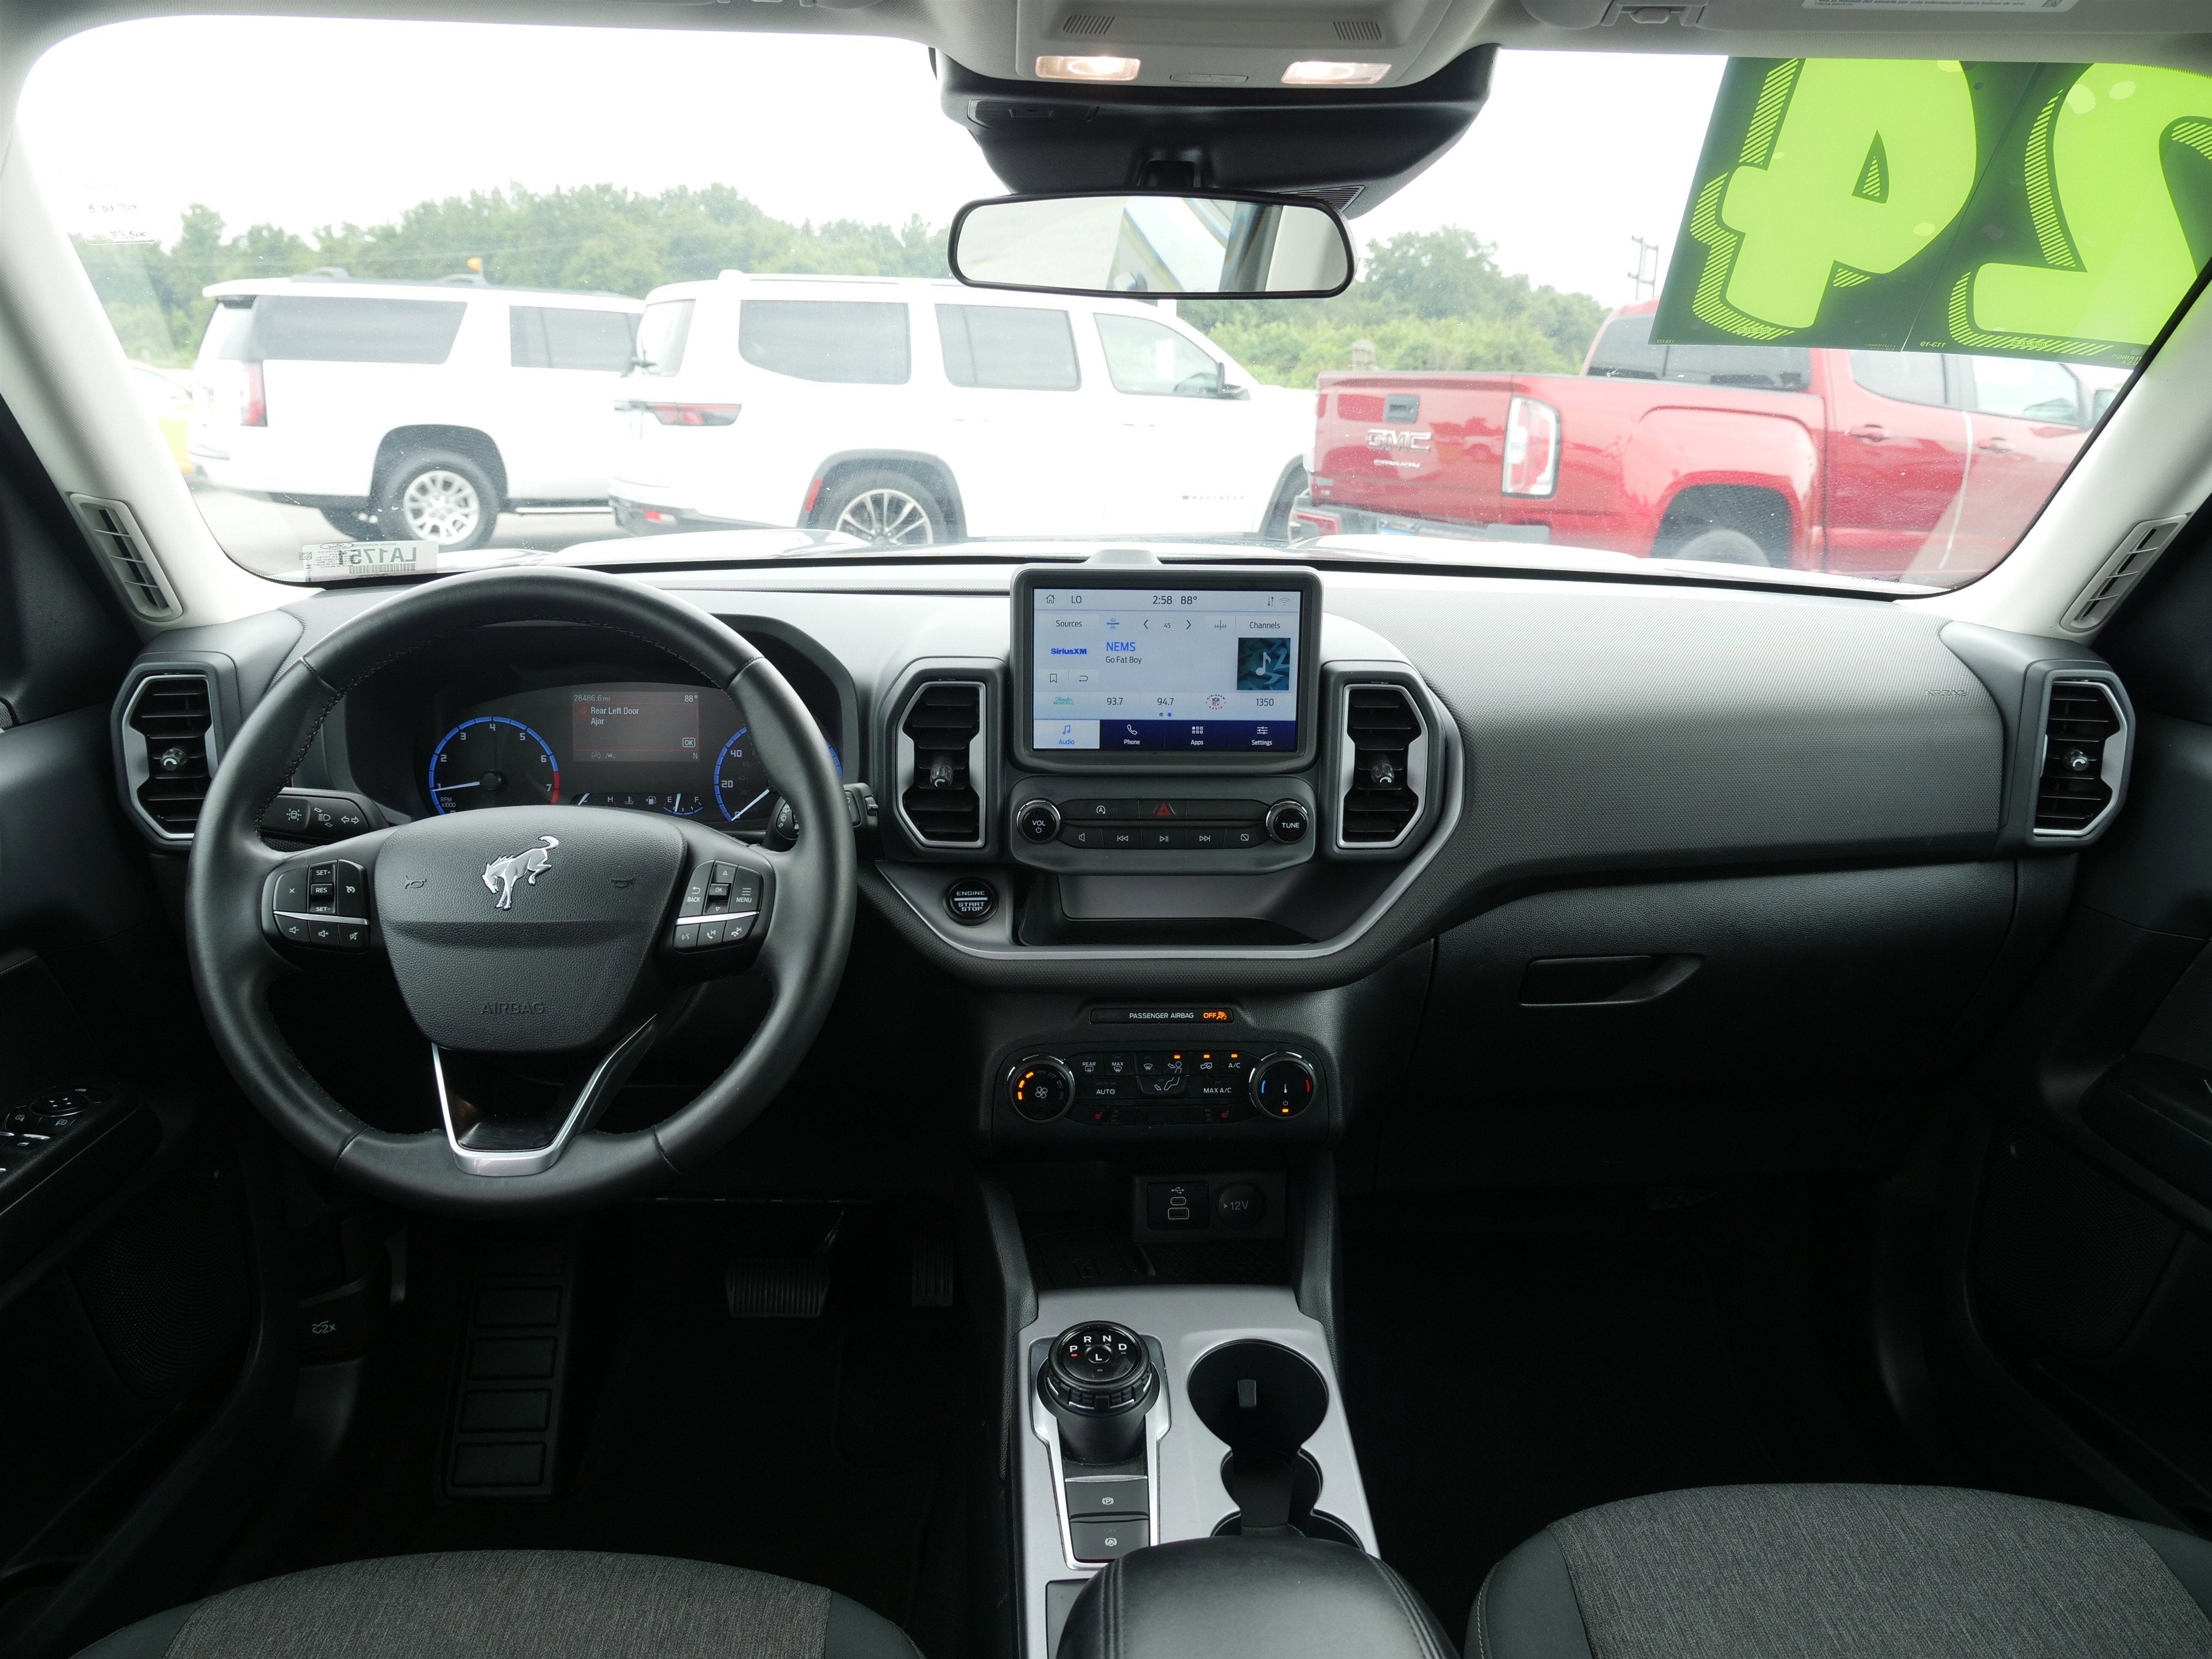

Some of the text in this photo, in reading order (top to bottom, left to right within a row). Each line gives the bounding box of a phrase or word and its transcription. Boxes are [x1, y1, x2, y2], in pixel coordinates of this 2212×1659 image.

[1367, 429, 1433, 453] GMC
[1071, 596, 1082, 604] LO
[1152, 596, 1197, 605] 2:58 88°
[1107, 642, 1136, 652] NEMS
[1129, 656, 1142, 664] Boy
[1107, 697, 1123, 705] 93.7
[1256, 698, 1274, 706] 1350
[591, 718, 604, 726] Ajar
[730, 750, 743, 758] 40
[481, 1001, 545, 1014] AIRBAG
[1230, 1201, 1249, 1210] 12V
